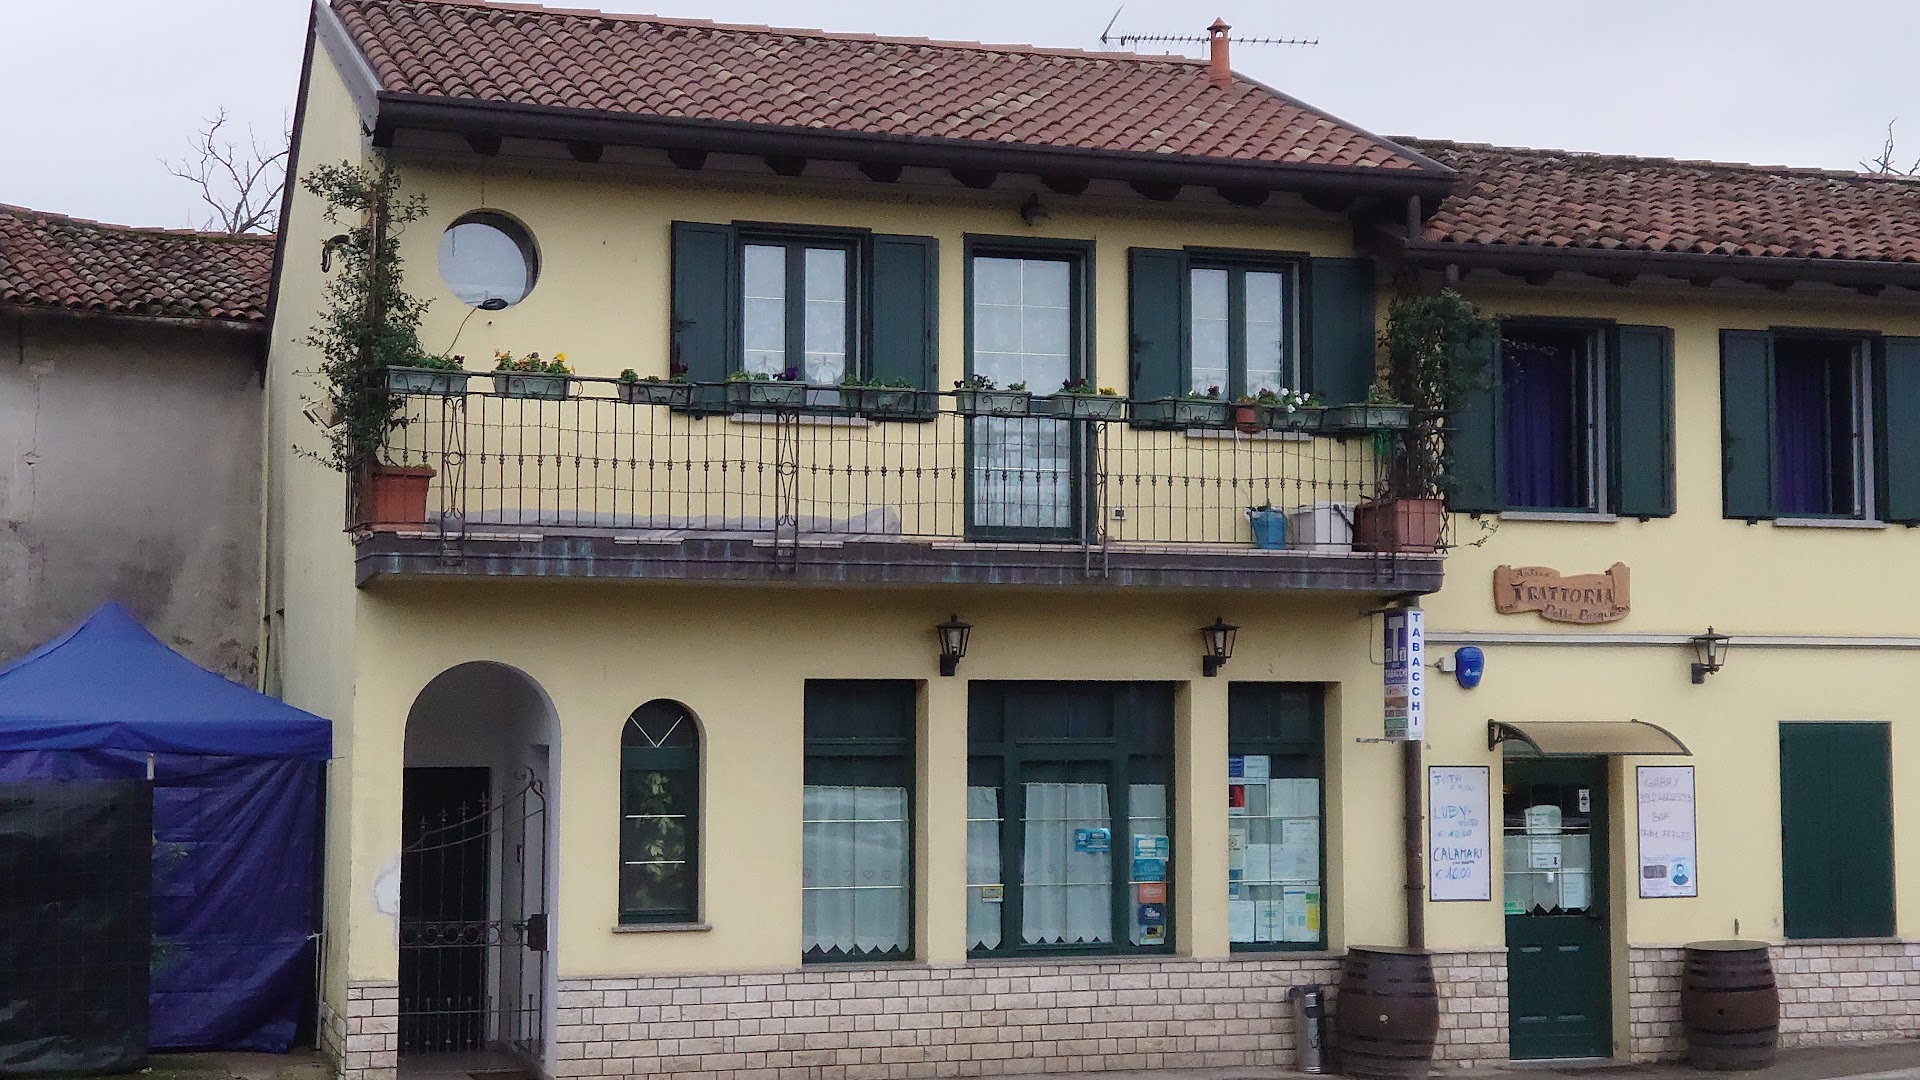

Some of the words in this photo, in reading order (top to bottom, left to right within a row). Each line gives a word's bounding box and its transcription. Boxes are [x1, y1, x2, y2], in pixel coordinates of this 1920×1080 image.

[1510, 581, 1615, 606] TRATTORIA
[1411, 612, 1421, 726] TABACCHI
[1433, 847, 1483, 861] CALAMARI
